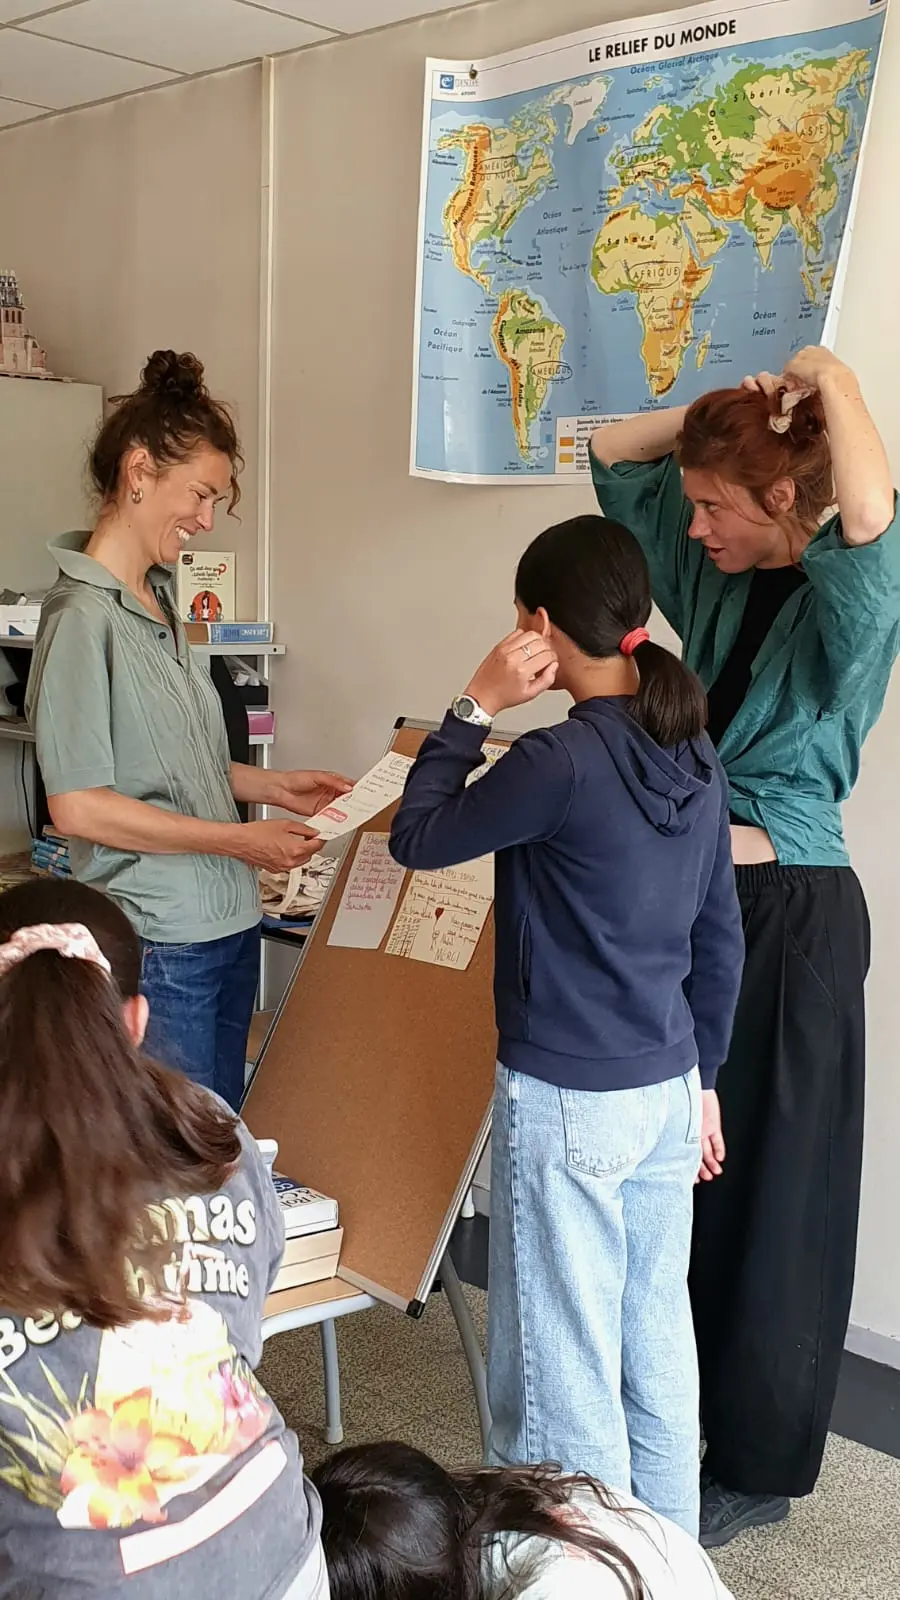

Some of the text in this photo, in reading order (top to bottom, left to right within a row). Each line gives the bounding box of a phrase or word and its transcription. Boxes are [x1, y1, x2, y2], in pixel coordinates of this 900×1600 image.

[589, 19, 736, 63] LE RELIEF DU MONDE
[630, 51, 719, 75] Océan Glacial Arctique
[800, 124, 825, 137] ASIE
[607, 235, 654, 246] Sahara
[633, 266, 679, 279] AFRIQUE
[753, 311, 776, 320] Océan
[433, 327, 458, 337] Océan
[752, 327, 776, 336] Indien
[427, 341, 463, 353] Pacifique
